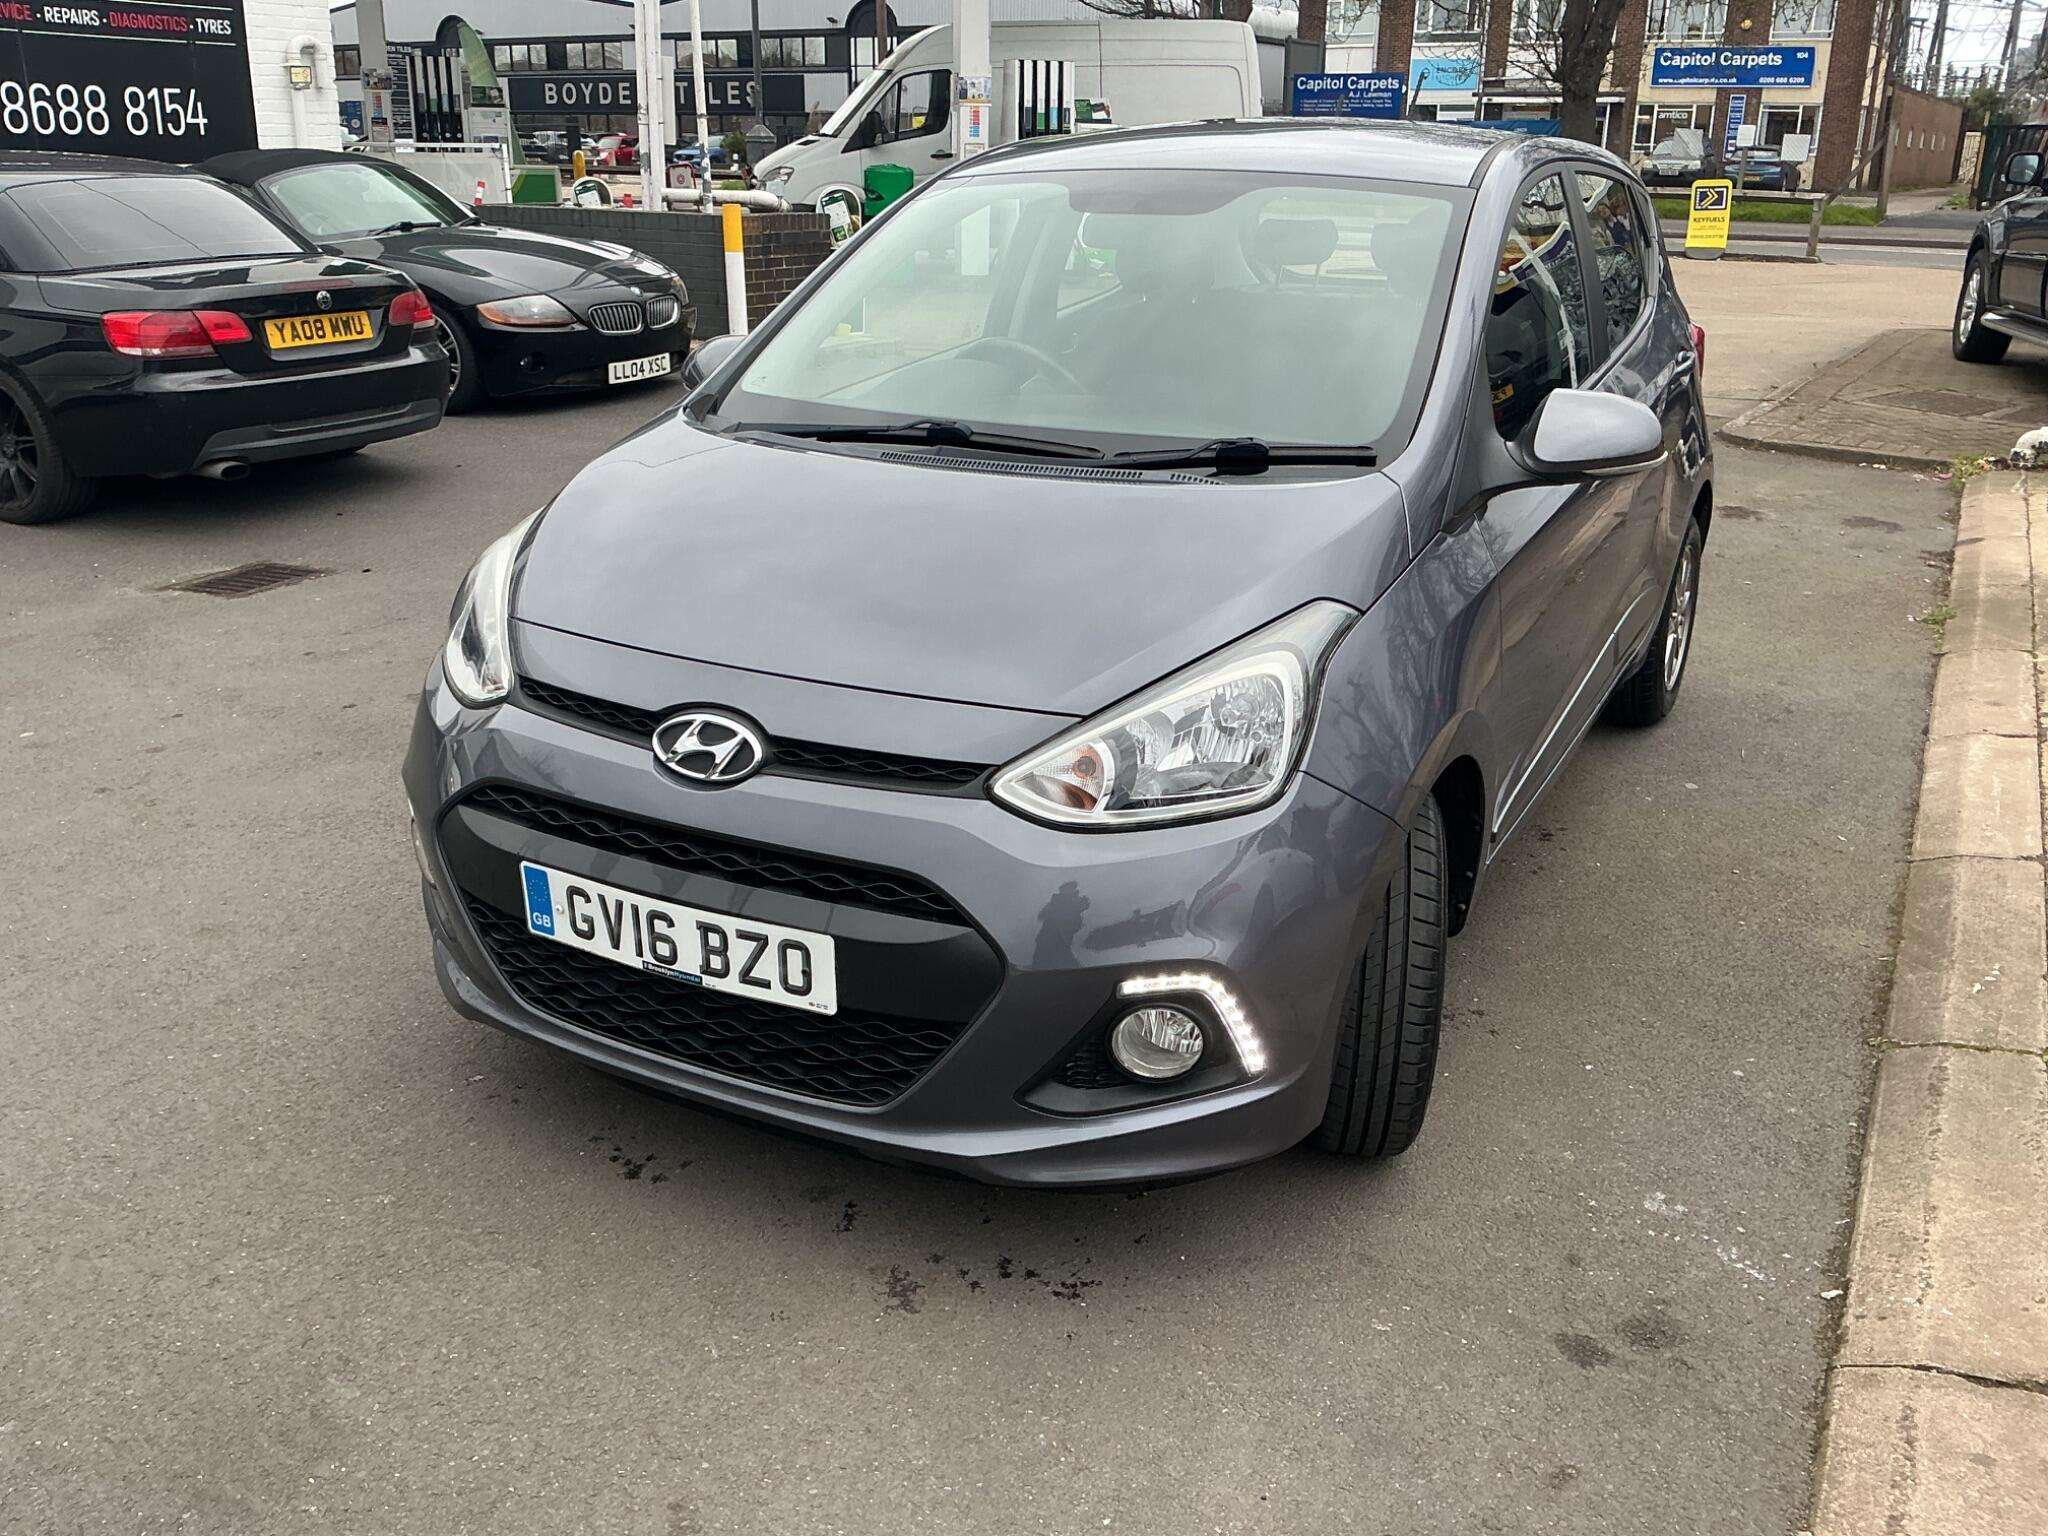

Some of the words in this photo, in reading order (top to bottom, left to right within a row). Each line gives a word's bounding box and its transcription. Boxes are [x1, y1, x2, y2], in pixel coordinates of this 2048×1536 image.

[0, 3, 33, 20] VICE
[43, 6, 100, 26] REPAIRS
[109, 11, 188, 32] DIAGNOSTICS
[195, 18, 232, 35] TYRES
[1660, 52, 1715, 68] Capitol
[1720, 52, 1783, 69] Carpets
[544, 82, 632, 105] BOYDE
[675, 82, 757, 108] TLES
[1296, 76, 1344, 92] Capitol
[1347, 76, 1400, 92] Carpets
[0, 80, 110, 136] 8688
[124, 86, 208, 136] 8154
[1658, 111, 1688, 119] amtico
[274, 318, 326, 343] YA08
[614, 361, 645, 380] LL04
[648, 356, 667, 375] XSC
[533, 911, 552, 928] GB
[566, 885, 679, 967] GV16
[695, 919, 814, 997] BZO
